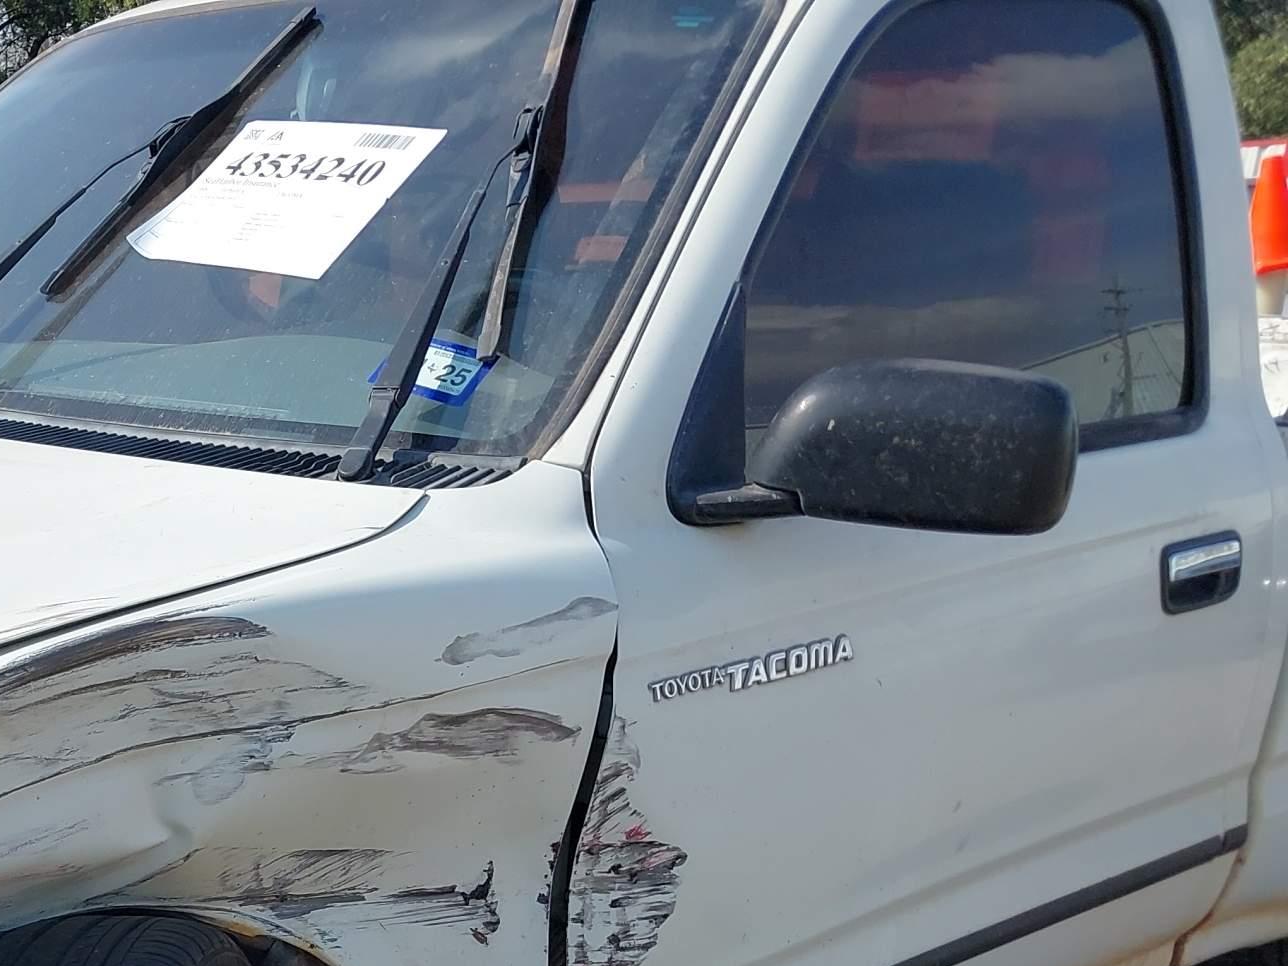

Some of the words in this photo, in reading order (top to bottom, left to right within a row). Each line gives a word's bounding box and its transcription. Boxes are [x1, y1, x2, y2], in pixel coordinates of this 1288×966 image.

[225, 152, 387, 187] 43534240
[434, 364, 473, 387] 25
[650, 667, 725, 703] TOYOTA
[725, 634, 855, 693] TACOMA
